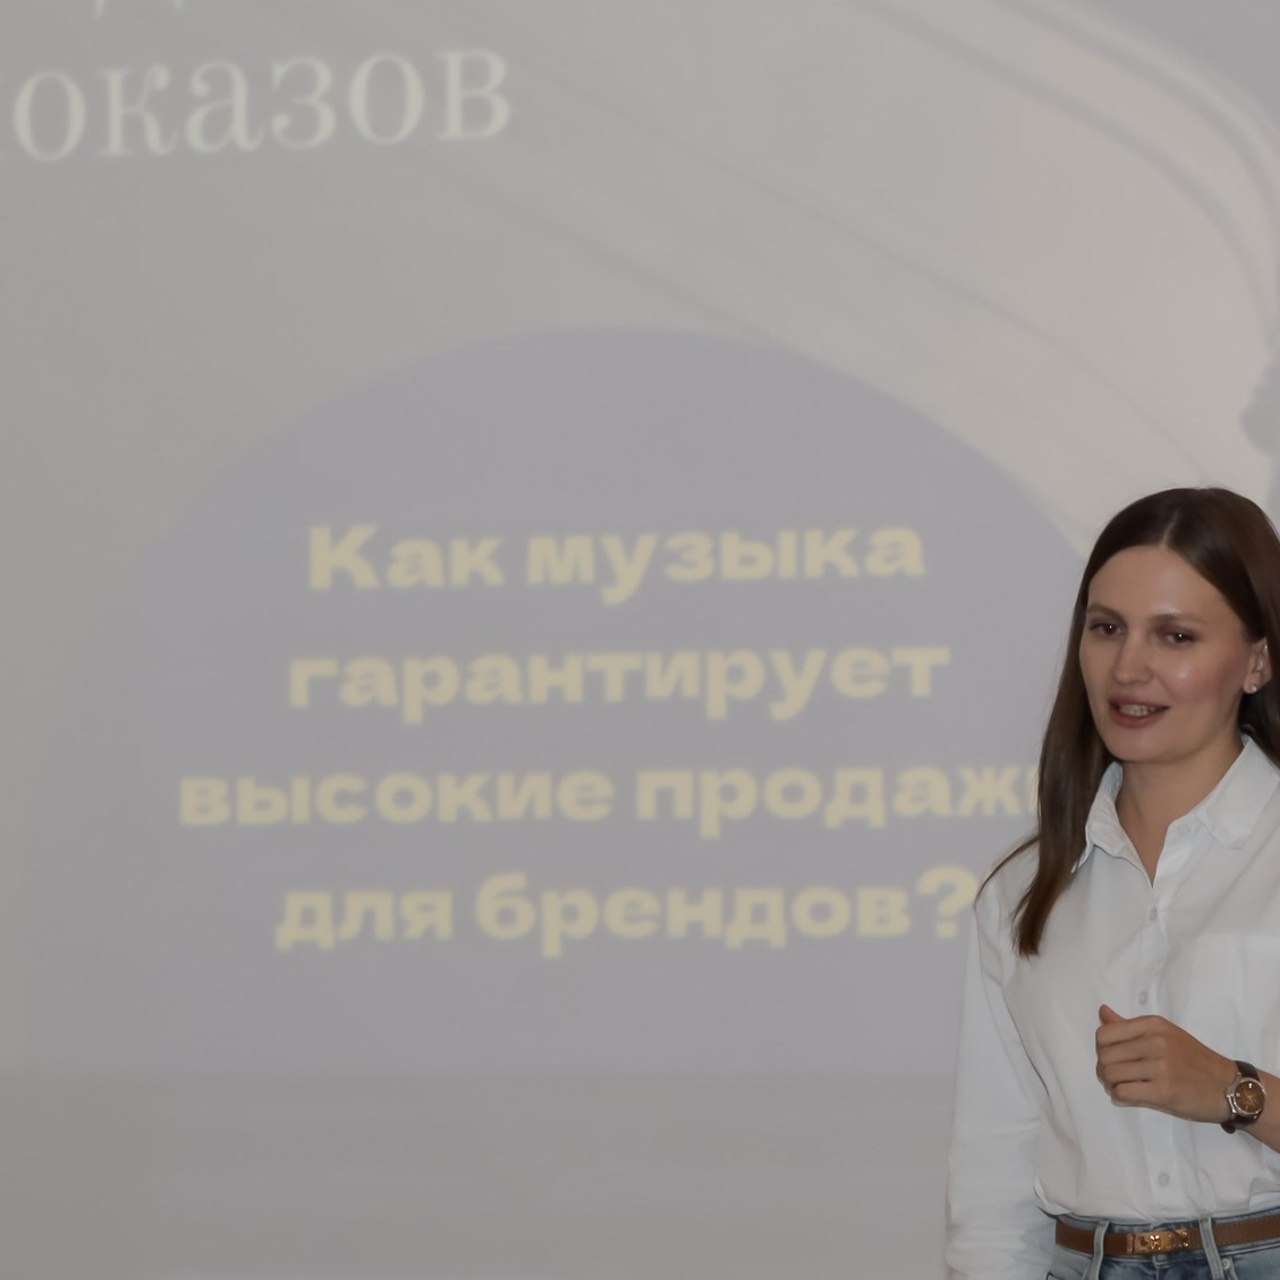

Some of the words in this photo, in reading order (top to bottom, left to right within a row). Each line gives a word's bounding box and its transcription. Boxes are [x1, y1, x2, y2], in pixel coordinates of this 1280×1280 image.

[0, 48, 513, 162] оказов
[307, 523, 504, 590] Как
[525, 525, 926, 606] музыка
[287, 645, 951, 725] гарантирует
[178, 768, 615, 828] высокие
[635, 764, 1038, 839] продаж
[273, 887, 454, 952] для
[473, 864, 978, 959] брендов?
